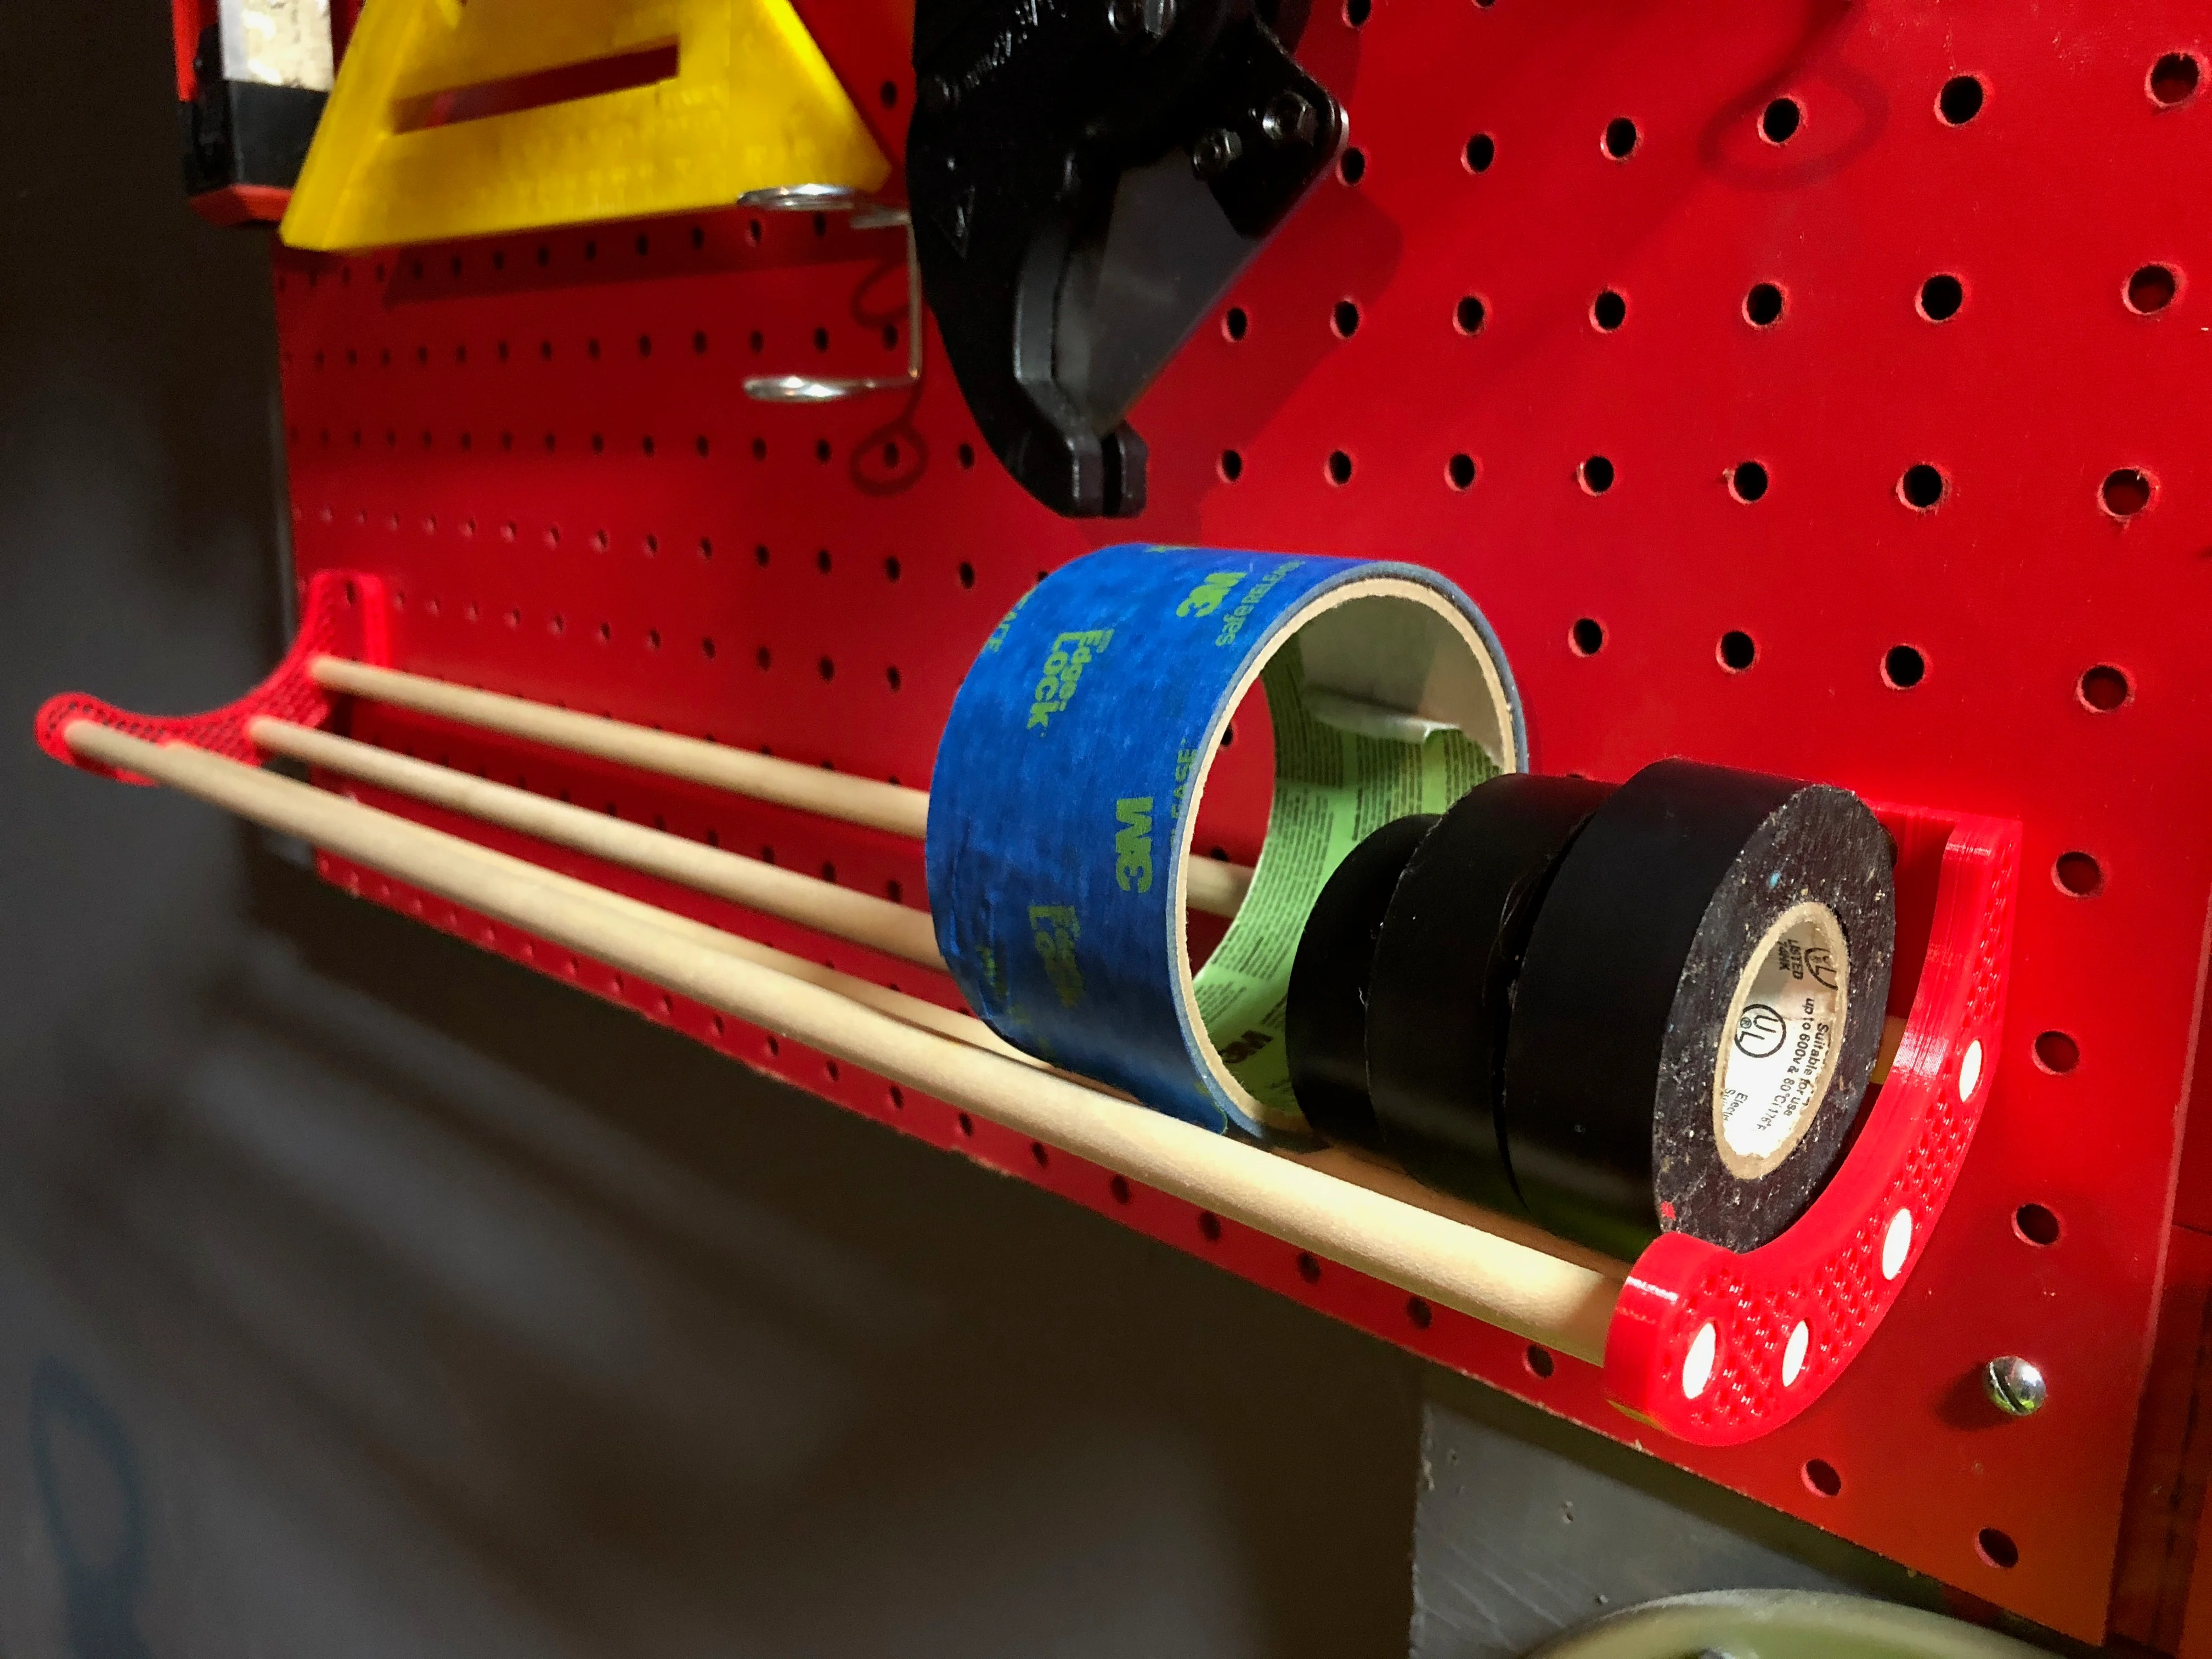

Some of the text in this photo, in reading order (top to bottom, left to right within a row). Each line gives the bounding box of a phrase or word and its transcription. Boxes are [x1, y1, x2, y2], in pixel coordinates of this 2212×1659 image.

[1115, 797, 1153, 893] 3M
[1788, 939, 1804, 980] LISTED
[1802, 998, 1814, 1015] up
[1802, 1017, 1814, 1031] to
[1792, 1032, 1811, 1064] 600v
[1803, 1023, 1829, 1076] Suitable
[1787, 1065, 1800, 1074] &
[1797, 1077, 1812, 1096] for
[1784, 1097, 1801, 1116] use
